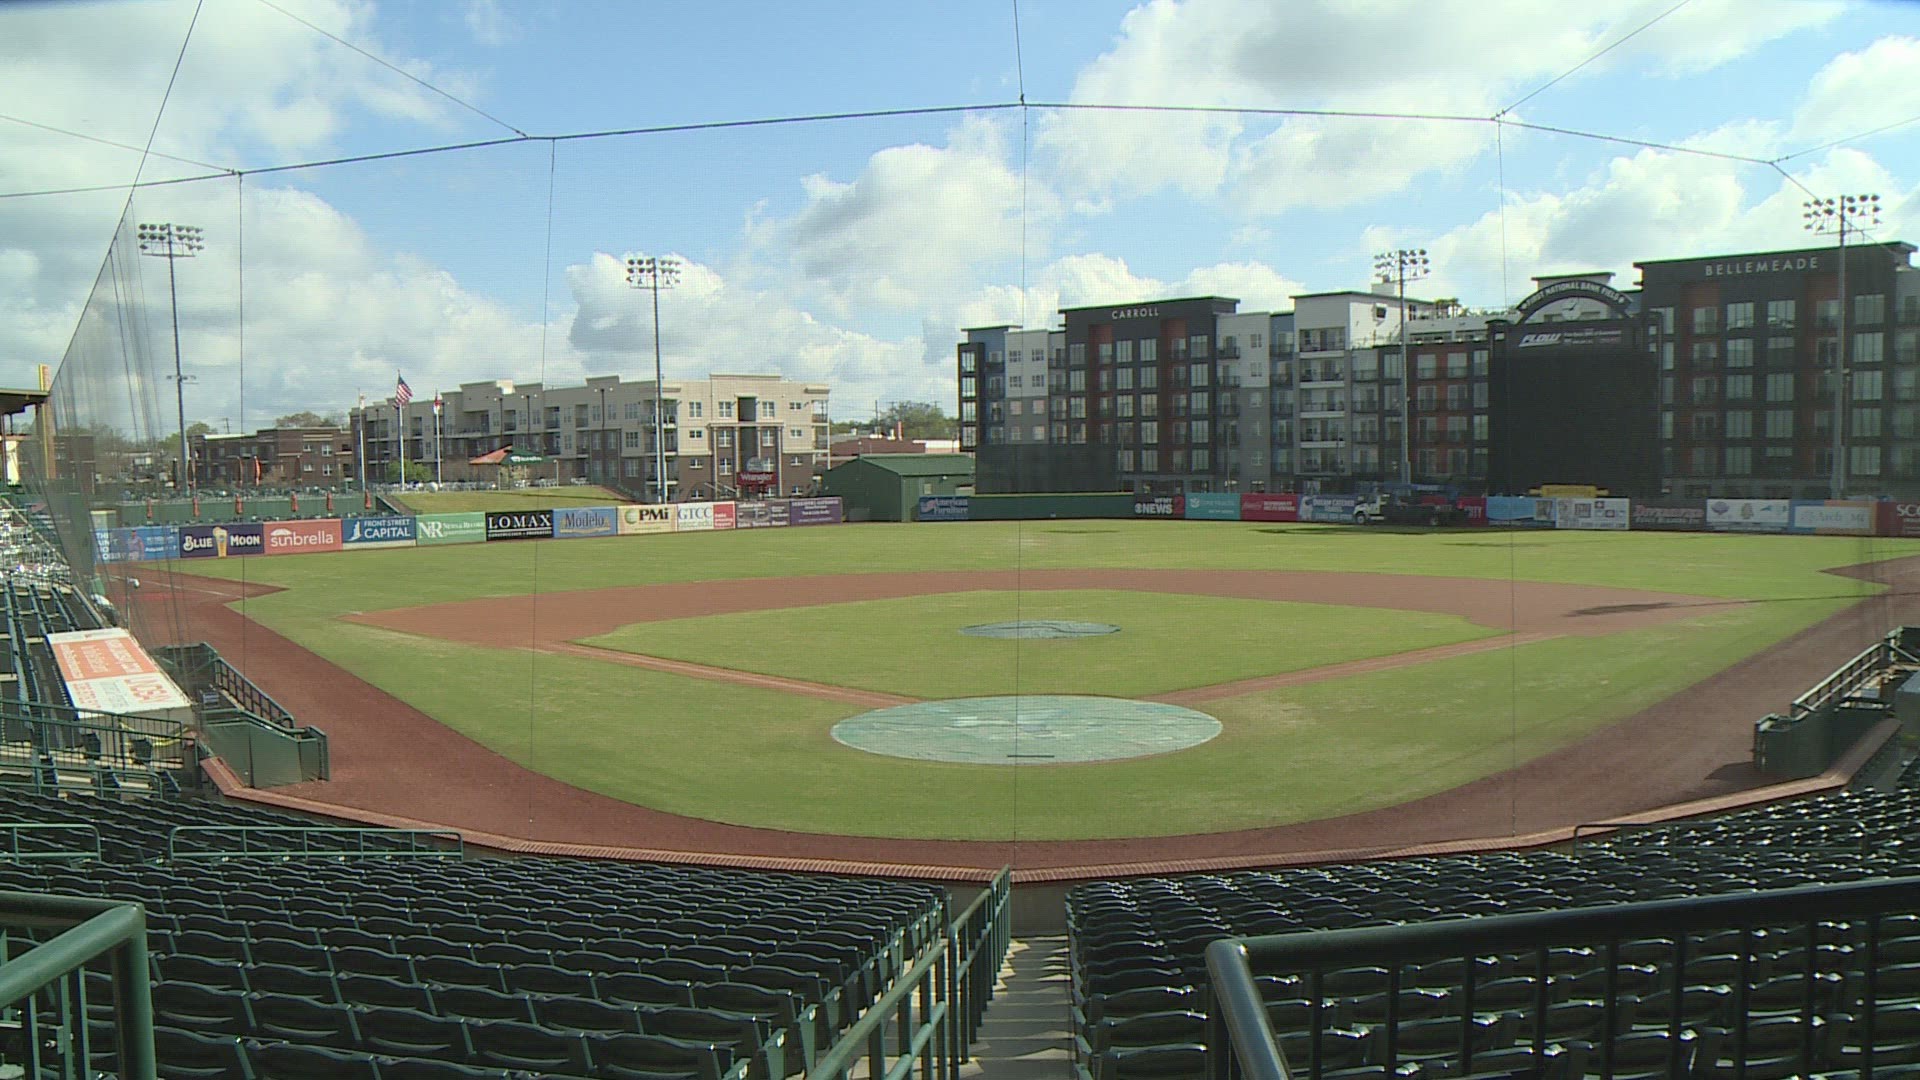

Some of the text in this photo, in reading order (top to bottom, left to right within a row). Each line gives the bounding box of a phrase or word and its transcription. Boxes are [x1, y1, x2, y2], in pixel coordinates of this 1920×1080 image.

[1705, 257, 1818, 276] BELLEMEADE
[1546, 282, 1580, 296] NATIONAL
[1581, 282, 1601, 293] BANK
[1601, 286, 1619, 300] FIELD
[1111, 307, 1159, 320] CARROLL
[639, 508, 669, 520] PMi
[678, 507, 712, 520] GTCC
[934, 507, 968, 515] Furniture
[1142, 503, 1173, 514] NEWS
[364, 518, 410, 527] FRONT STREET
[488, 514, 551, 529] LOMAX
[566, 512, 605, 527] Modelo
[270, 530, 334, 547] sunbrella
[364, 527, 411, 539] CAPITAL
[183, 535, 213, 551] BLUE
[230, 535, 260, 547] MOON
